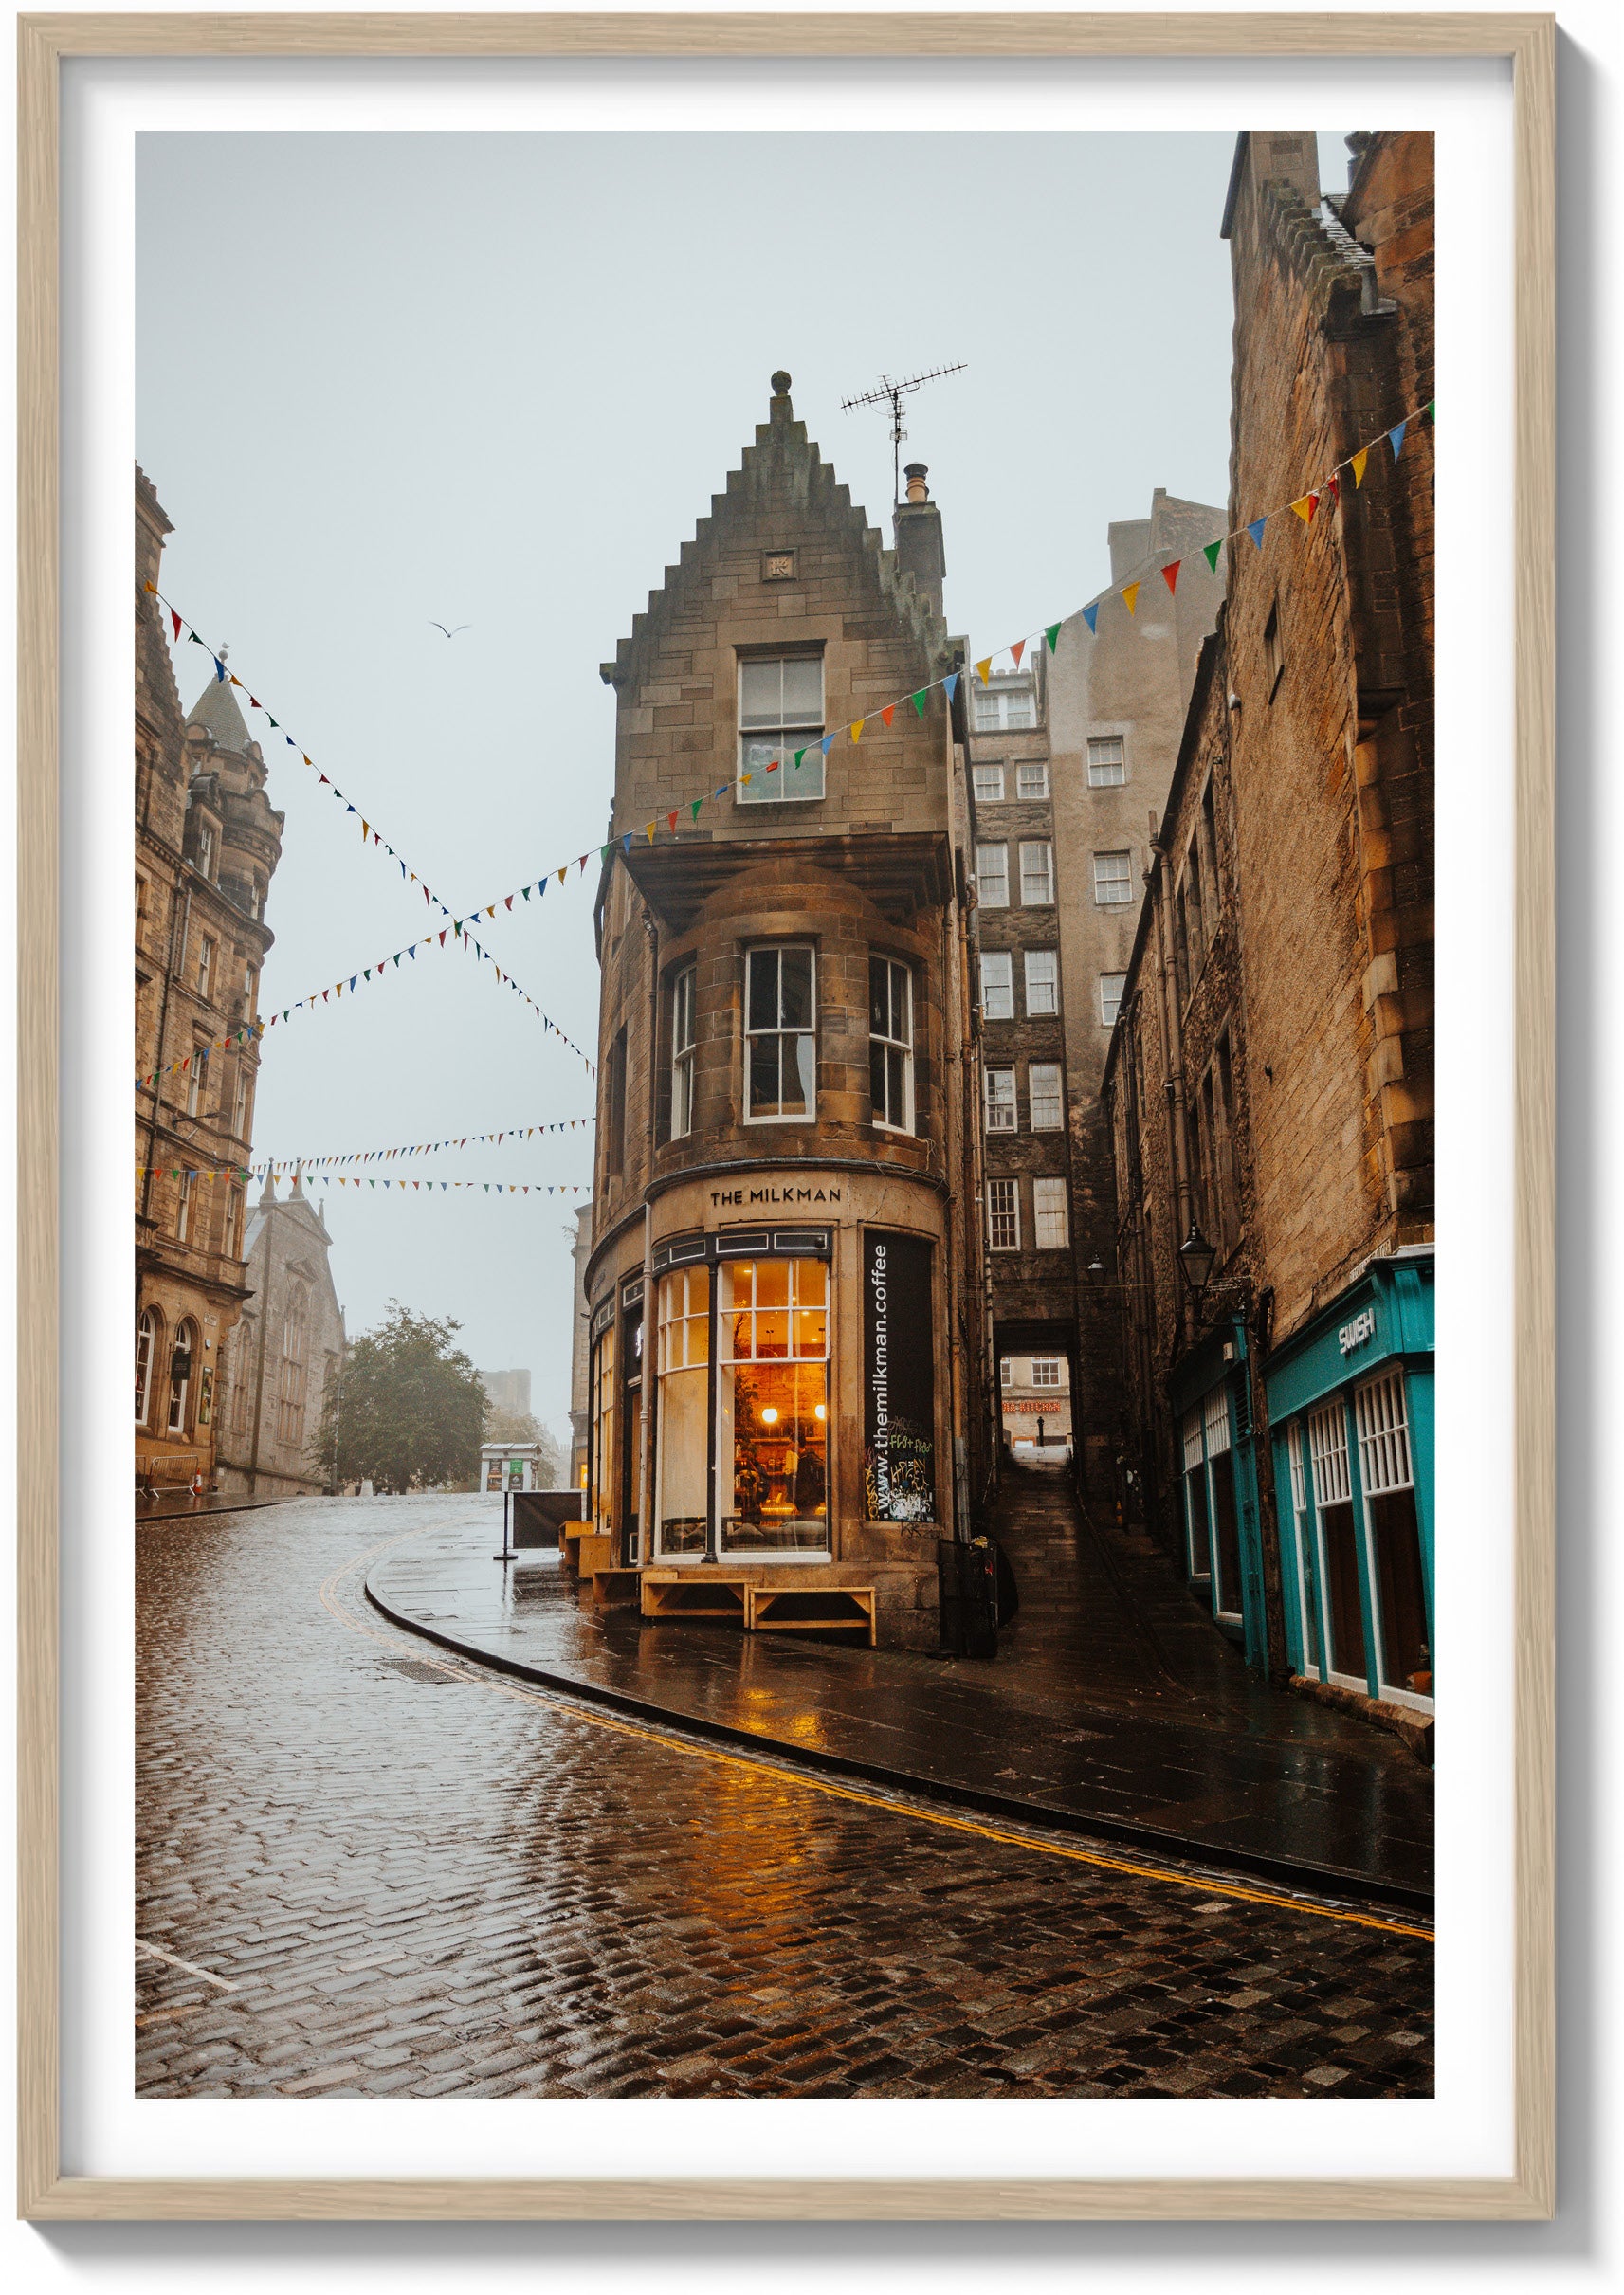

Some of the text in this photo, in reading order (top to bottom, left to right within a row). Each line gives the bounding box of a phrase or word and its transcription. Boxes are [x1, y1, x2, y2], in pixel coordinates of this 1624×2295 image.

[711, 1187, 841, 1206] THE MILKMAN
[1339, 1307, 1376, 1355] SWISH
[871, 1245, 889, 1510] www.themilkman.coffee
